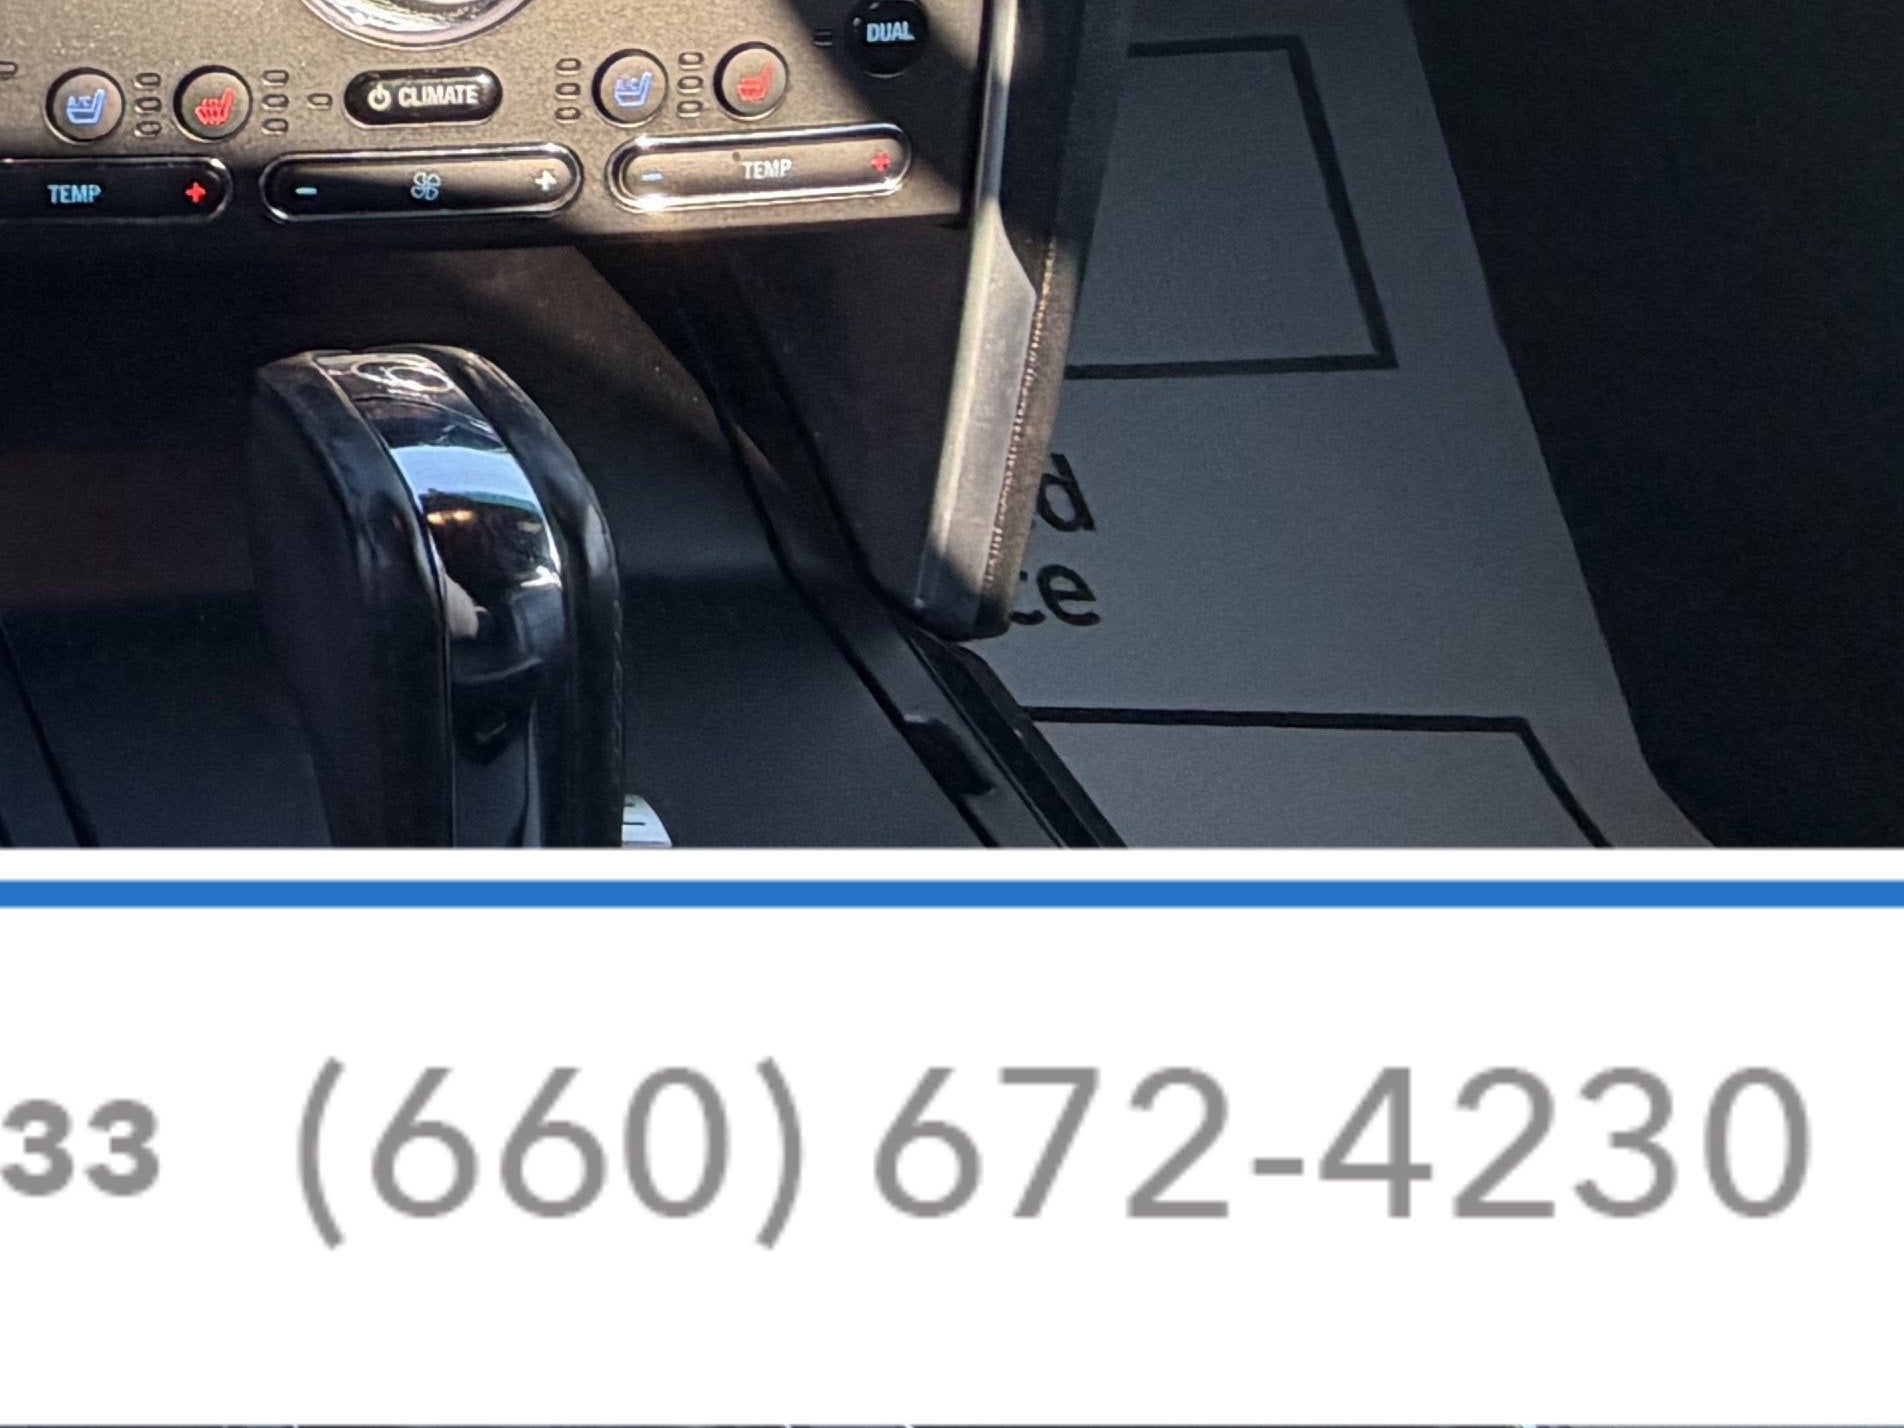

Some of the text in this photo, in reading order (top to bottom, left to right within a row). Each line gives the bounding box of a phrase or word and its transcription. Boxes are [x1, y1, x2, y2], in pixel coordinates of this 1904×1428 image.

[866, 20, 914, 42] DUAL
[398, 84, 479, 108] CLIMATE
[742, 157, 792, 180] TEMP
[47, 184, 101, 204] TEMP
